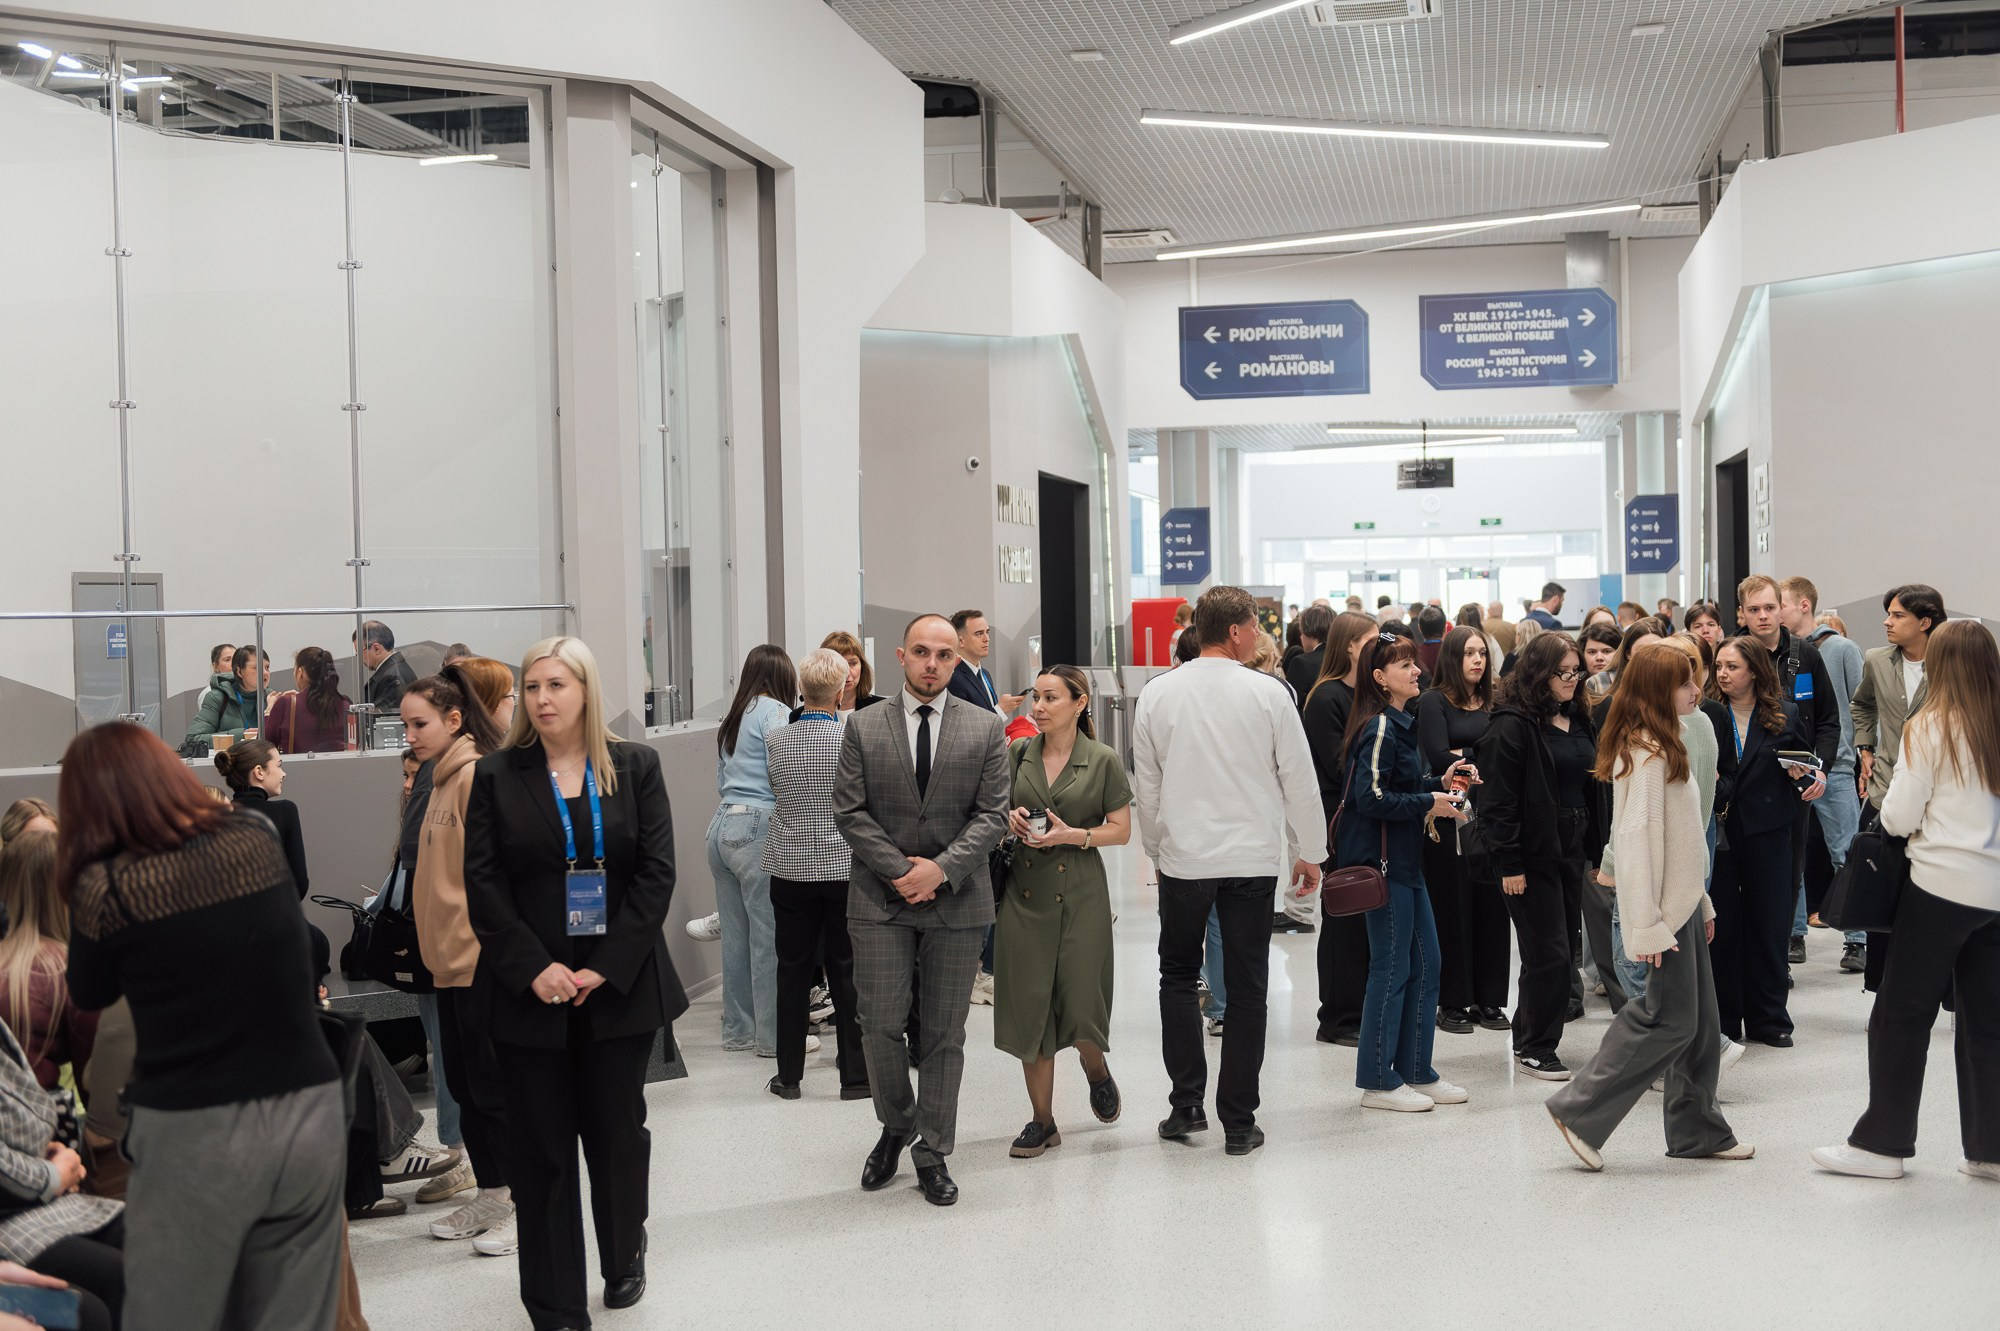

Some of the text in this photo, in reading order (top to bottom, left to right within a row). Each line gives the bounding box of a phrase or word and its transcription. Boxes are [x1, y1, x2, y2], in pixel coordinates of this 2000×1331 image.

[1487, 302, 1523, 310] ВЫСТАВКА
[1468, 311, 1488, 321] ВЕК
[1439, 318, 1569, 333] ОТ ВЕЛИКИХ ПОТРЯСЕНИЙ
[1229, 324, 1344, 342] РЮРИКОВИЧИ
[1456, 330, 1554, 343] К ВЕЛИКОЙ ПОБЕДЕ
[1489, 348, 1526, 356] ВЫСТАВКА
[1446, 358, 1485, 368] РОССИЯ
[1496, 356, 1520, 367] МОЯ
[1521, 354, 1568, 365] ИСТОРИЯ
[1239, 360, 1335, 378] РОМАНОВЫ
